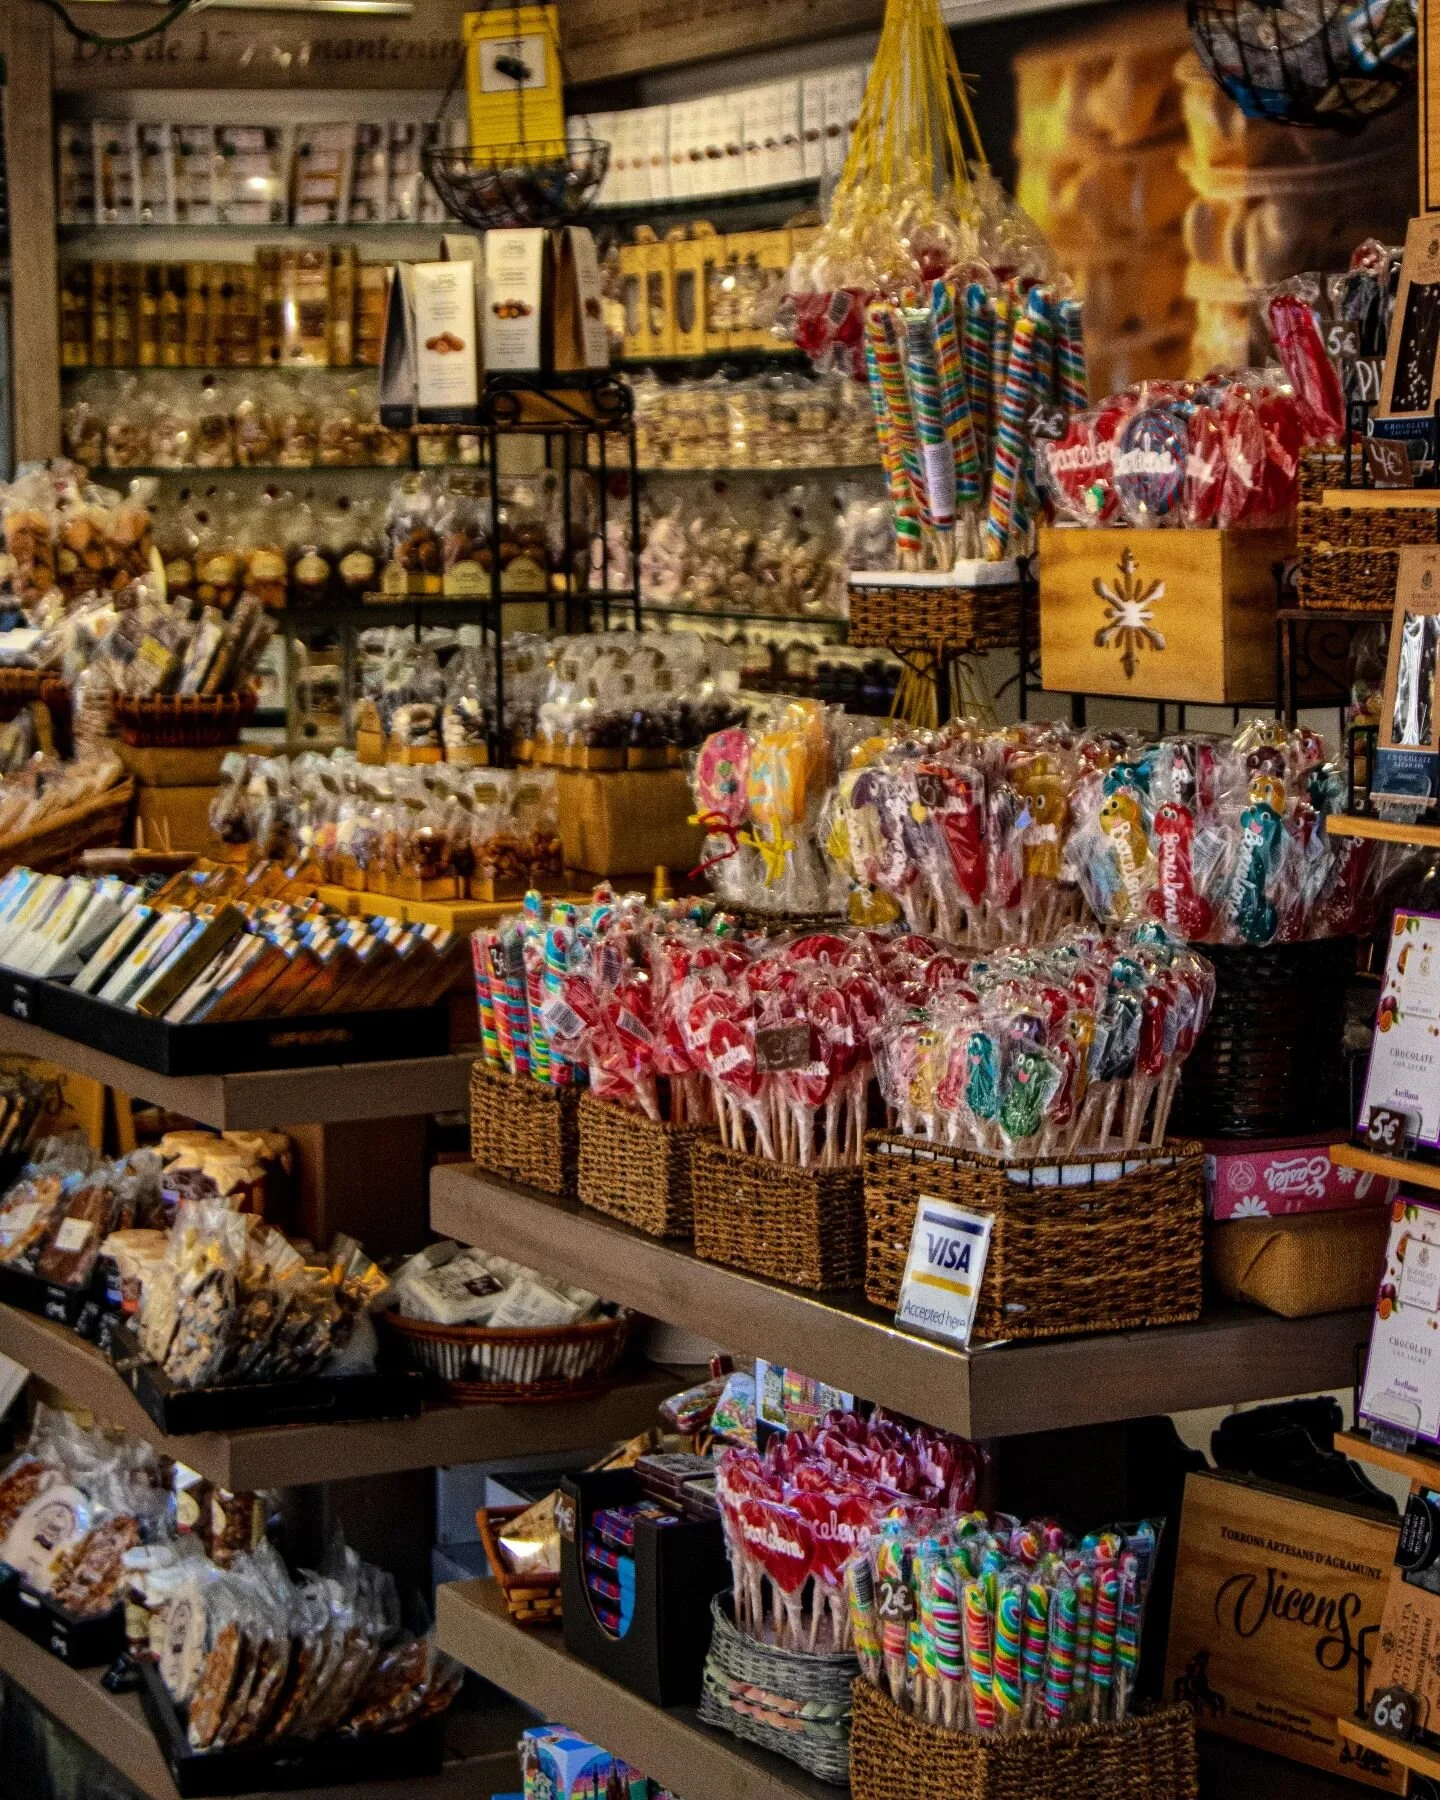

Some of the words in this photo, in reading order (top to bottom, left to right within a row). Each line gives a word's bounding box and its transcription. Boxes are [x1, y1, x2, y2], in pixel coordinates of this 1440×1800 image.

[1327, 326, 1357, 355] 5€
[1026, 404, 1064, 433] 4€
[1161, 832, 1185, 925] Barcelona
[1390, 1047, 1434, 1064] CHOCOLATE
[1368, 1111, 1399, 1146] 5€
[926, 1233, 972, 1273] VISA
[904, 1299, 946, 1325] Accepted
[1389, 1335, 1433, 1357] CHOCOLATE
[1220, 1525, 1266, 1549] TORRONS
[1266, 1538, 1314, 1563] ARTESANS
[878, 1582, 913, 1617] 2€
[1214, 1566, 1374, 1672] Vicens
[1373, 1694, 1407, 1730] 6€
